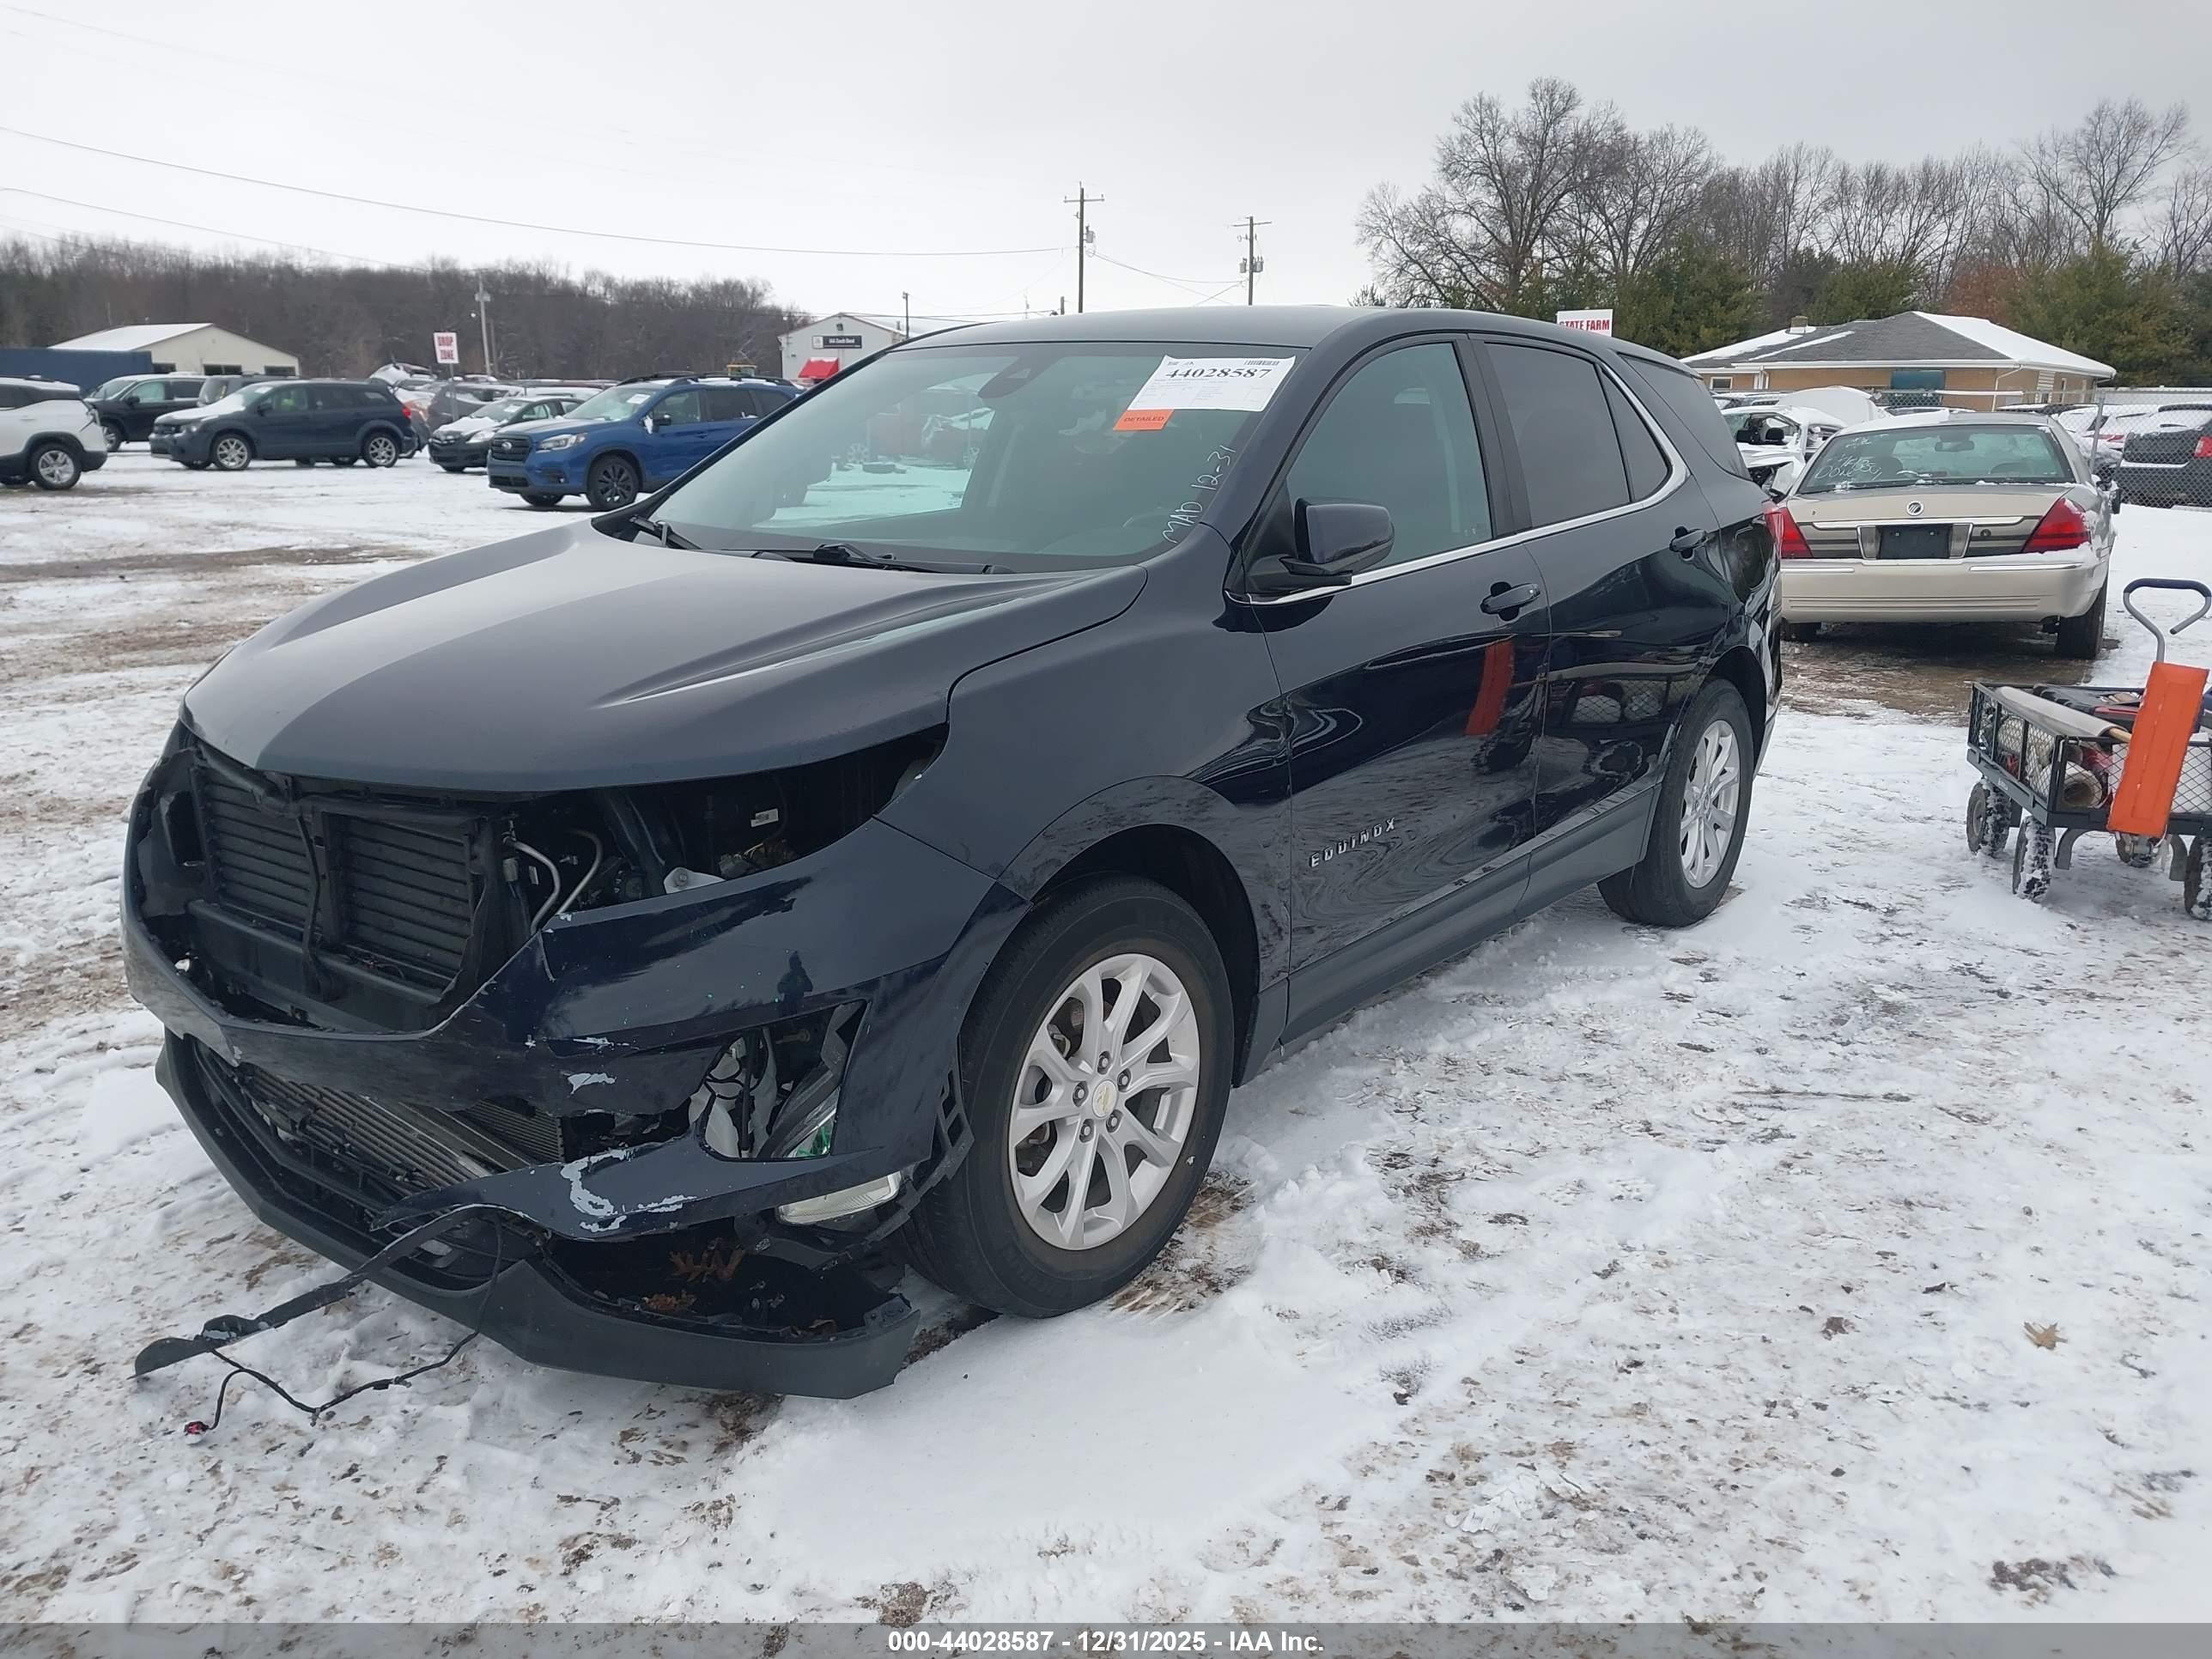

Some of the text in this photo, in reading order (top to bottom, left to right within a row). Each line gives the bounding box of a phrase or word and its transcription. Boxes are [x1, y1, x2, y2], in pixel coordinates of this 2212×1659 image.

[1586, 319, 1610, 331] FARM
[1165, 368, 1273, 379] 44028587
[1310, 817, 1395, 867] EQUINOX
